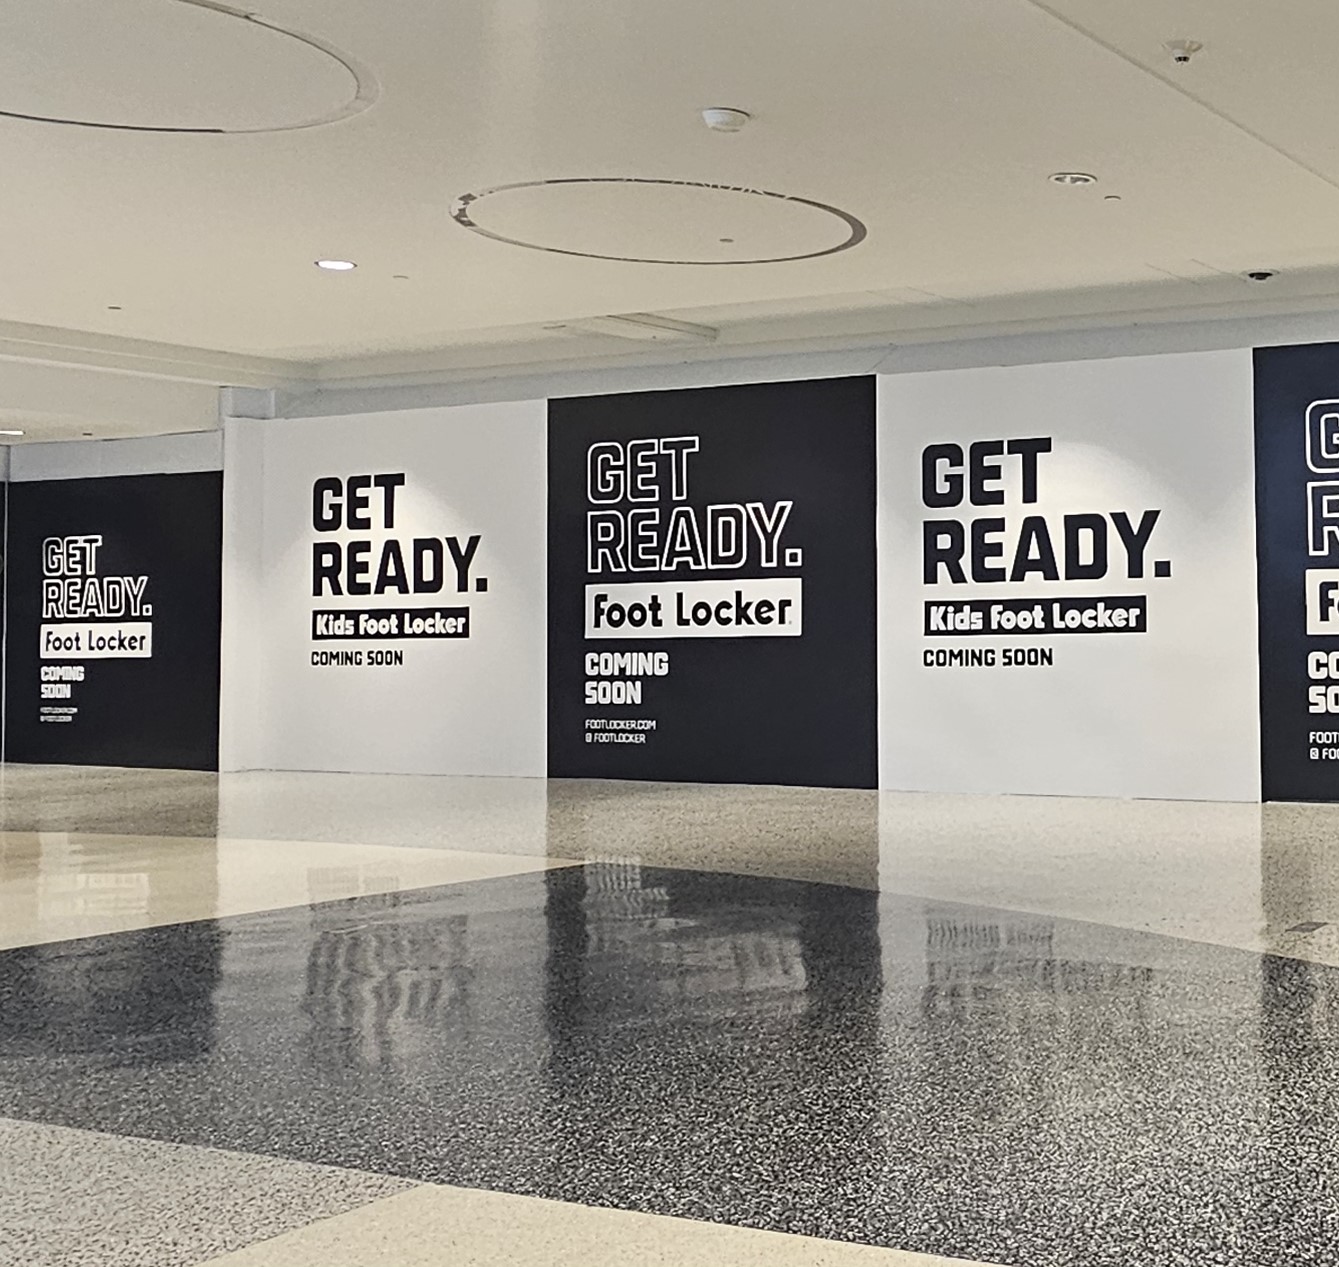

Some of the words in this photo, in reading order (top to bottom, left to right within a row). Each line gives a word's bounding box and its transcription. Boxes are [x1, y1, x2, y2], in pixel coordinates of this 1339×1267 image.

[587, 436, 699, 504] GET
[922, 437, 1052, 508] GET
[313, 473, 405, 532] GET
[587, 500, 802, 573] READY.
[923, 509, 1171, 584] READY.
[43, 535, 102, 576] GET
[312, 535, 488, 597] READY.
[42, 576, 152, 618] READY.
[593, 593, 663, 628] Foot
[676, 591, 792, 626] Locker
[316, 614, 355, 636] Kids
[359, 614, 398, 635] Foot
[404, 612, 466, 634] Locker
[930, 606, 983, 631] Kids
[990, 605, 1045, 629] Foot
[1052, 602, 1140, 628] Locker
[45, 631, 81, 652] Foot
[88, 630, 146, 651] Locker
[311, 651, 362, 666] COMING
[367, 650, 403, 665] SOON
[585, 652, 669, 676] COMING
[923, 649, 996, 667] COMING
[1002, 648, 1053, 666] SOON
[40, 666, 85, 682] COMING
[40, 683, 72, 699] SOON
[585, 681, 642, 704] SOON
[585, 719, 656, 731] FOOTLOCKER.COM
[593, 733, 646, 744] FOOTLOCKER
